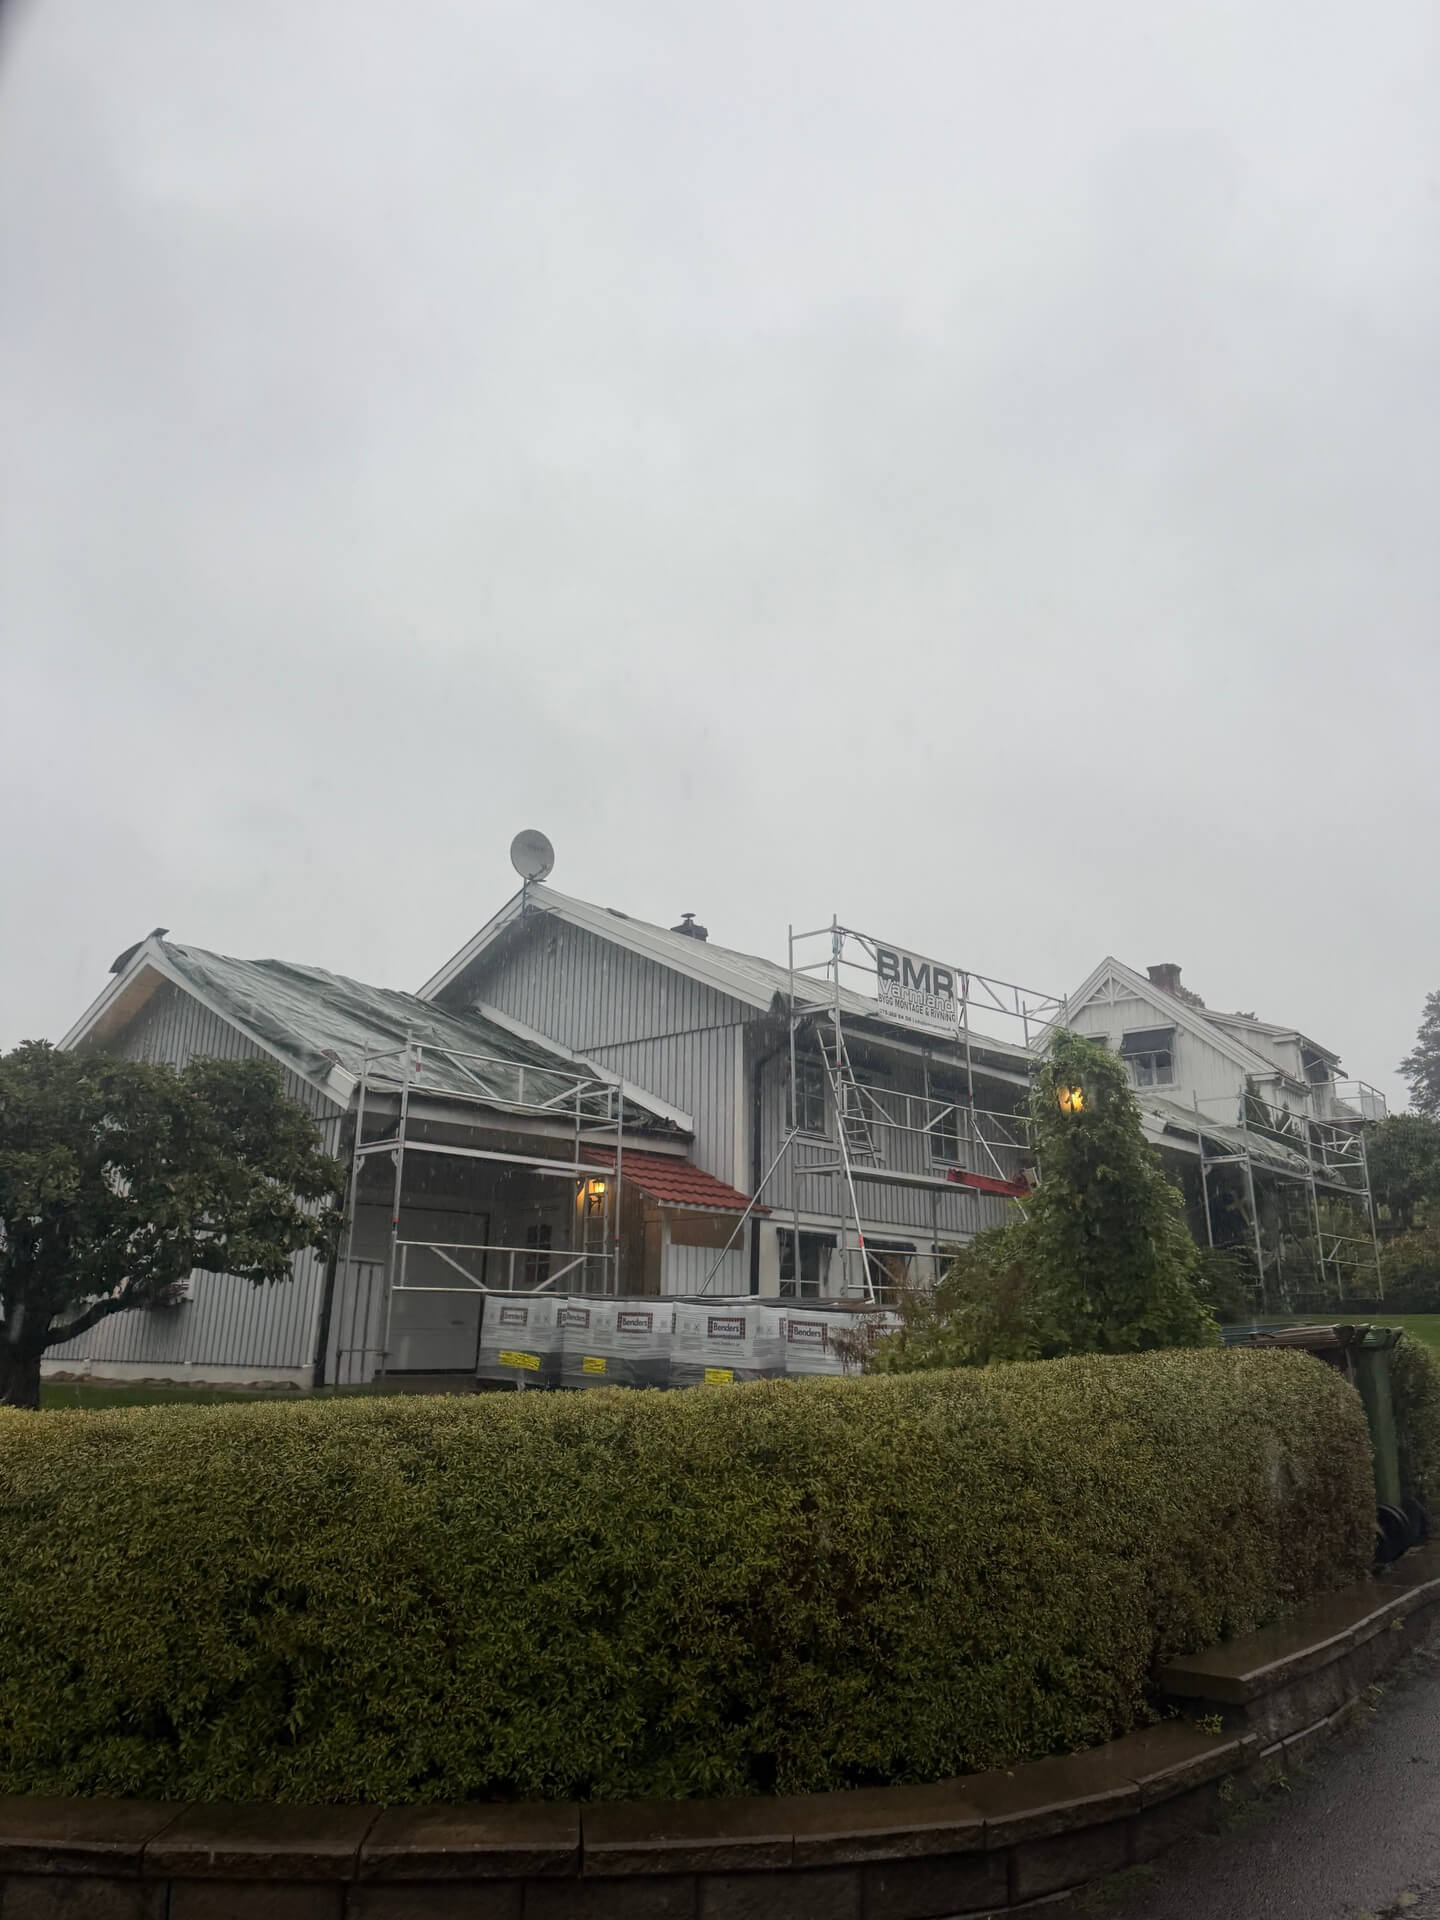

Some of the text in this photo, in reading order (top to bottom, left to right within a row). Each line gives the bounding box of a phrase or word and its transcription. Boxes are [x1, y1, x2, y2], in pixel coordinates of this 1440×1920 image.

[877, 948, 954, 1000] BMR
[879, 977, 955, 1012] Värmland
[878, 992, 894, 1006] BYGG
[895, 998, 923, 1015] MONTAGE
[925, 1006, 930, 1016] &
[930, 1010, 956, 1023] RIVNING
[622, 1317, 647, 1327] Benders
[713, 1322, 739, 1332] Benders
[793, 1326, 821, 1337] Benders
